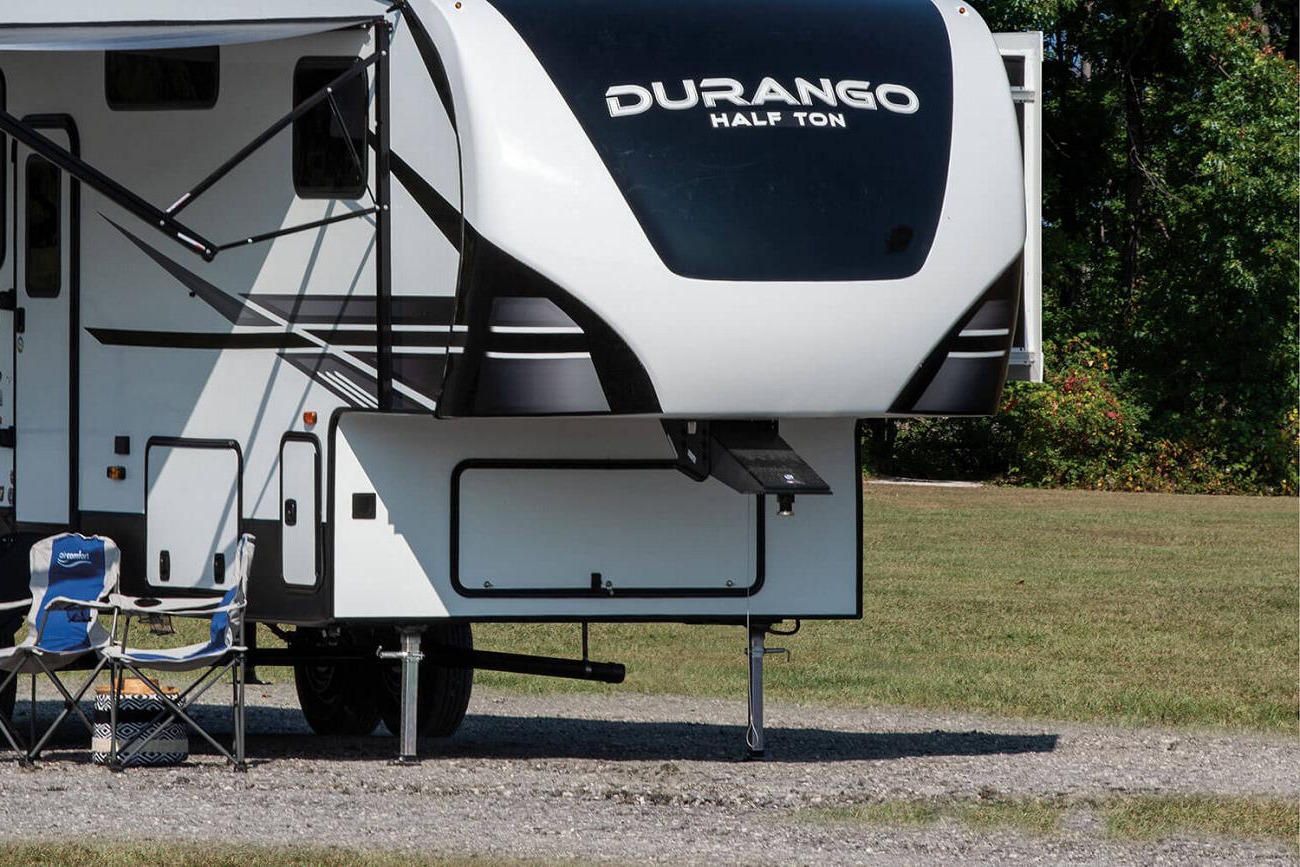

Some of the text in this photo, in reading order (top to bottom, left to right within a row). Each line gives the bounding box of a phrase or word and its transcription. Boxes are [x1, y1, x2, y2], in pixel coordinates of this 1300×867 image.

[605, 76, 920, 118] DURANGO
[711, 111, 847, 128] HALF TON
